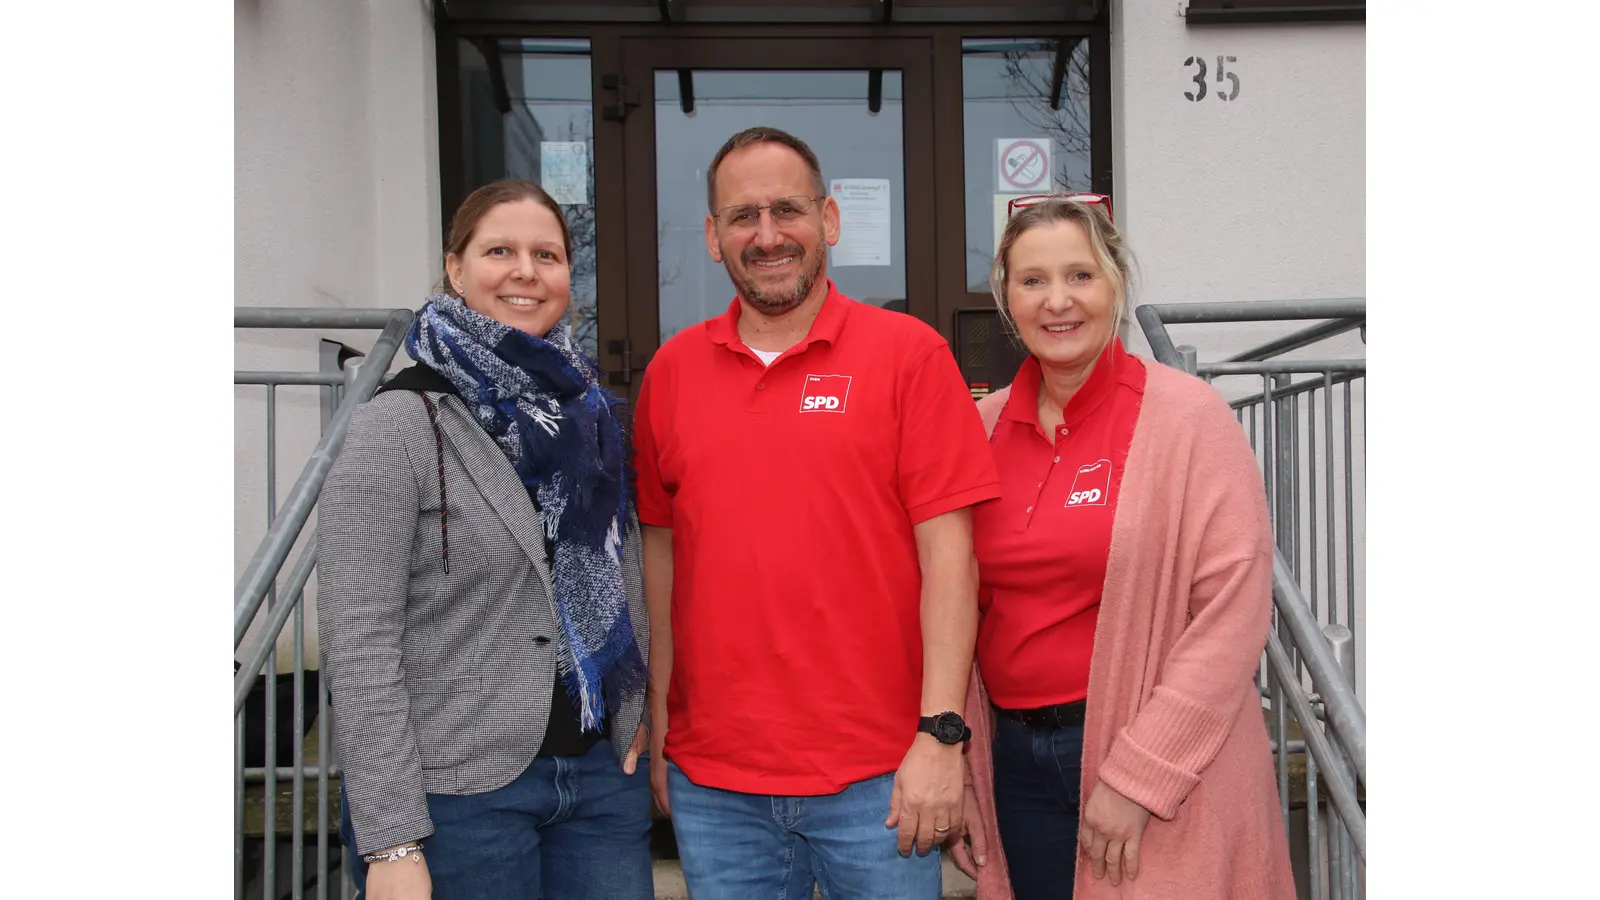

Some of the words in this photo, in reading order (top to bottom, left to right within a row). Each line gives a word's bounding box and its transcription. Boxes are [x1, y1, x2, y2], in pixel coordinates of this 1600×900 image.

[1184, 55, 1240, 102] 35
[803, 396, 839, 410] SPD
[1068, 488, 1101, 504] SPD
